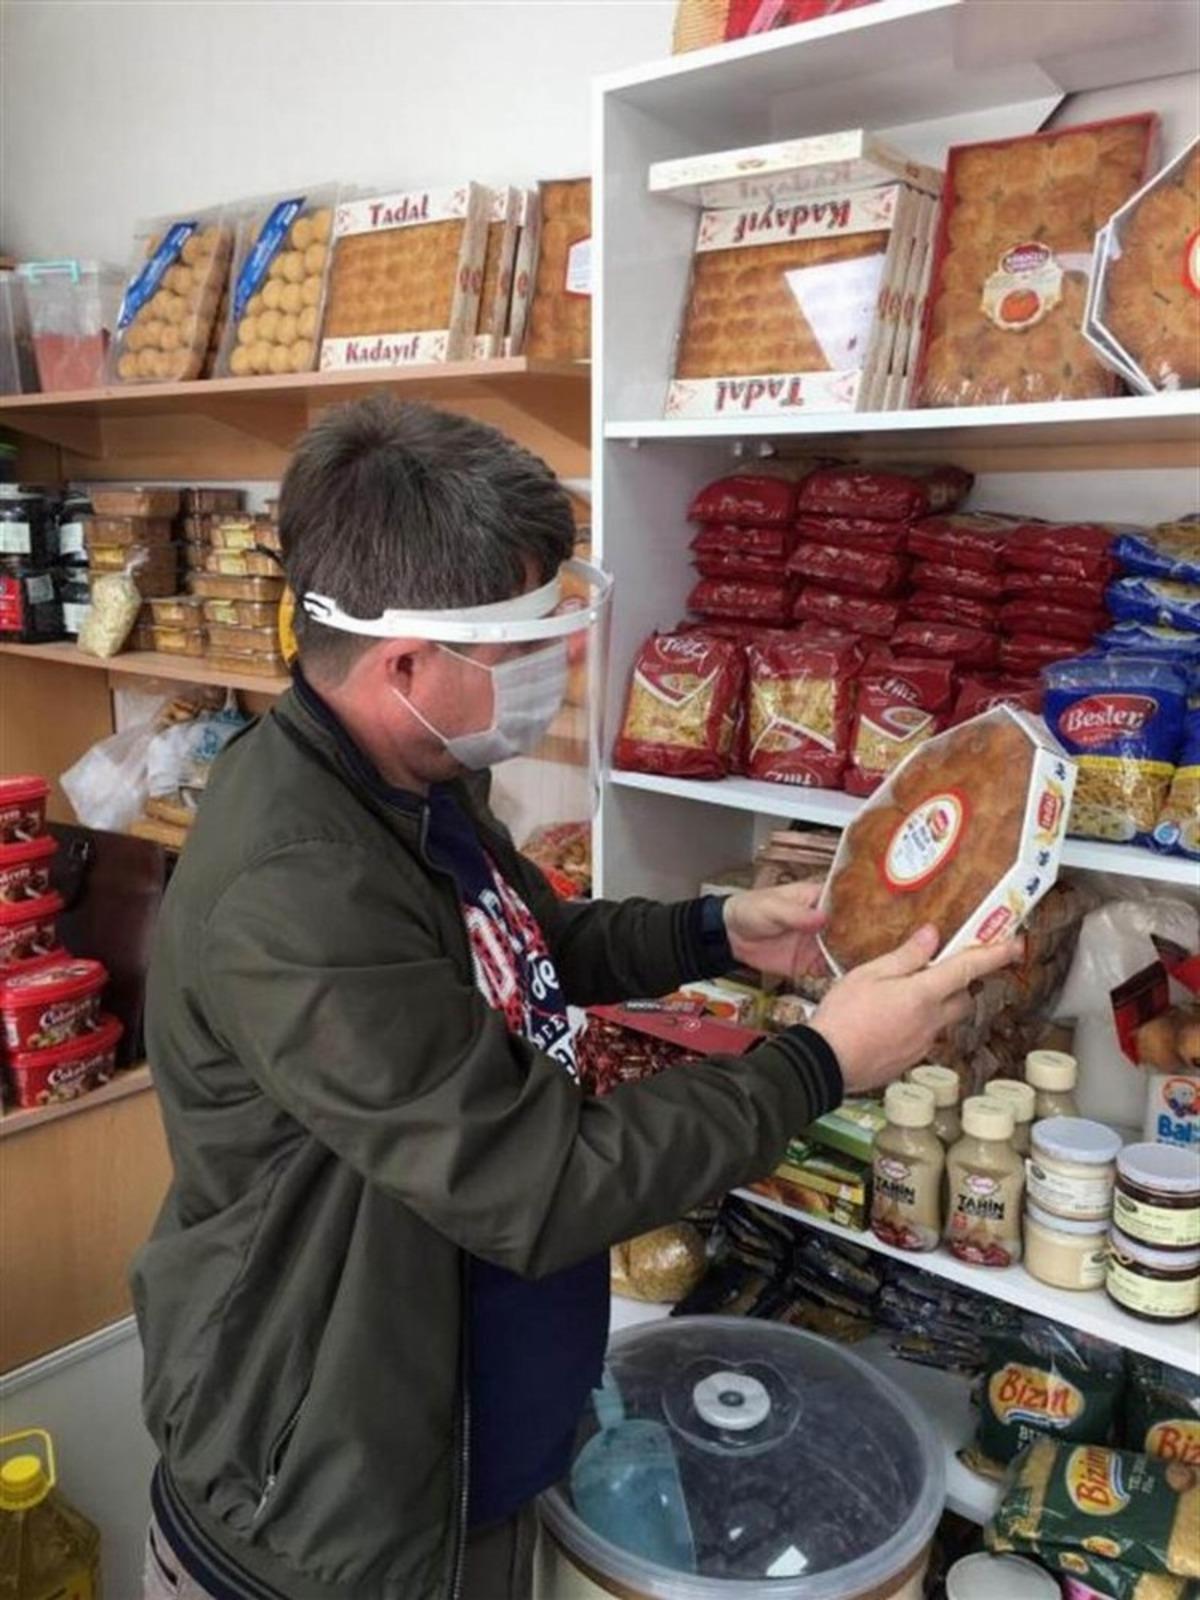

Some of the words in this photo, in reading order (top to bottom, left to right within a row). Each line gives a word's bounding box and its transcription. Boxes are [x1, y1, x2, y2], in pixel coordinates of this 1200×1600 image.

[369, 195, 429, 226] Tadal
[715, 377, 804, 410] Tadal
[1067, 705, 1144, 732] Besler
